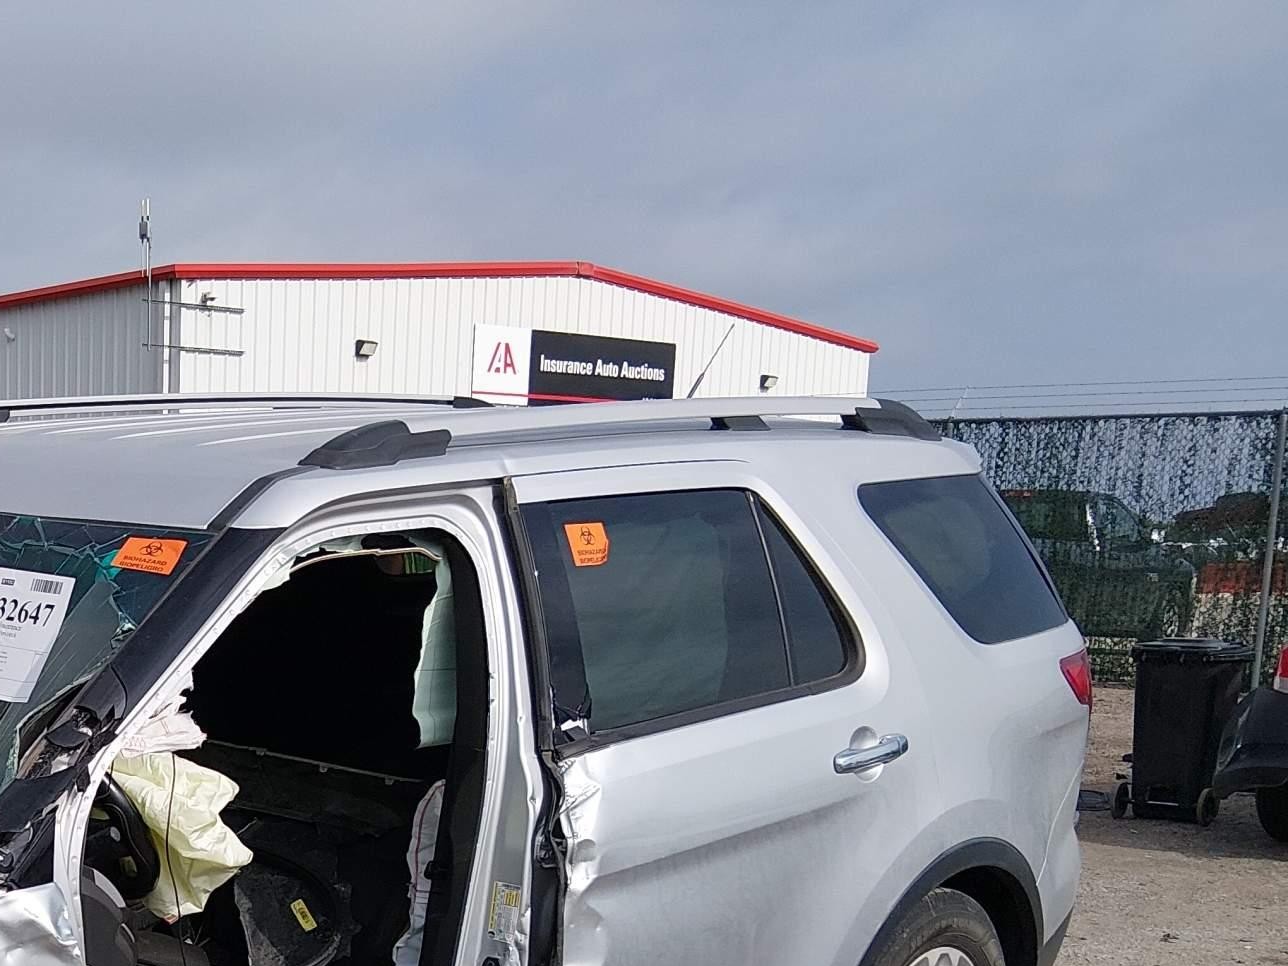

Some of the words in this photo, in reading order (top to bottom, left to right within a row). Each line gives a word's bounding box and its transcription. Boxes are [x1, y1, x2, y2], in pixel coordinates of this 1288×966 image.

[540, 354, 593, 376] Insurance
[594, 359, 620, 378] Auto
[619, 361, 665, 381] Auctions
[119, 561, 165, 572] BIOPELIGRO
[122, 555, 168, 567] BIOHAZARD
